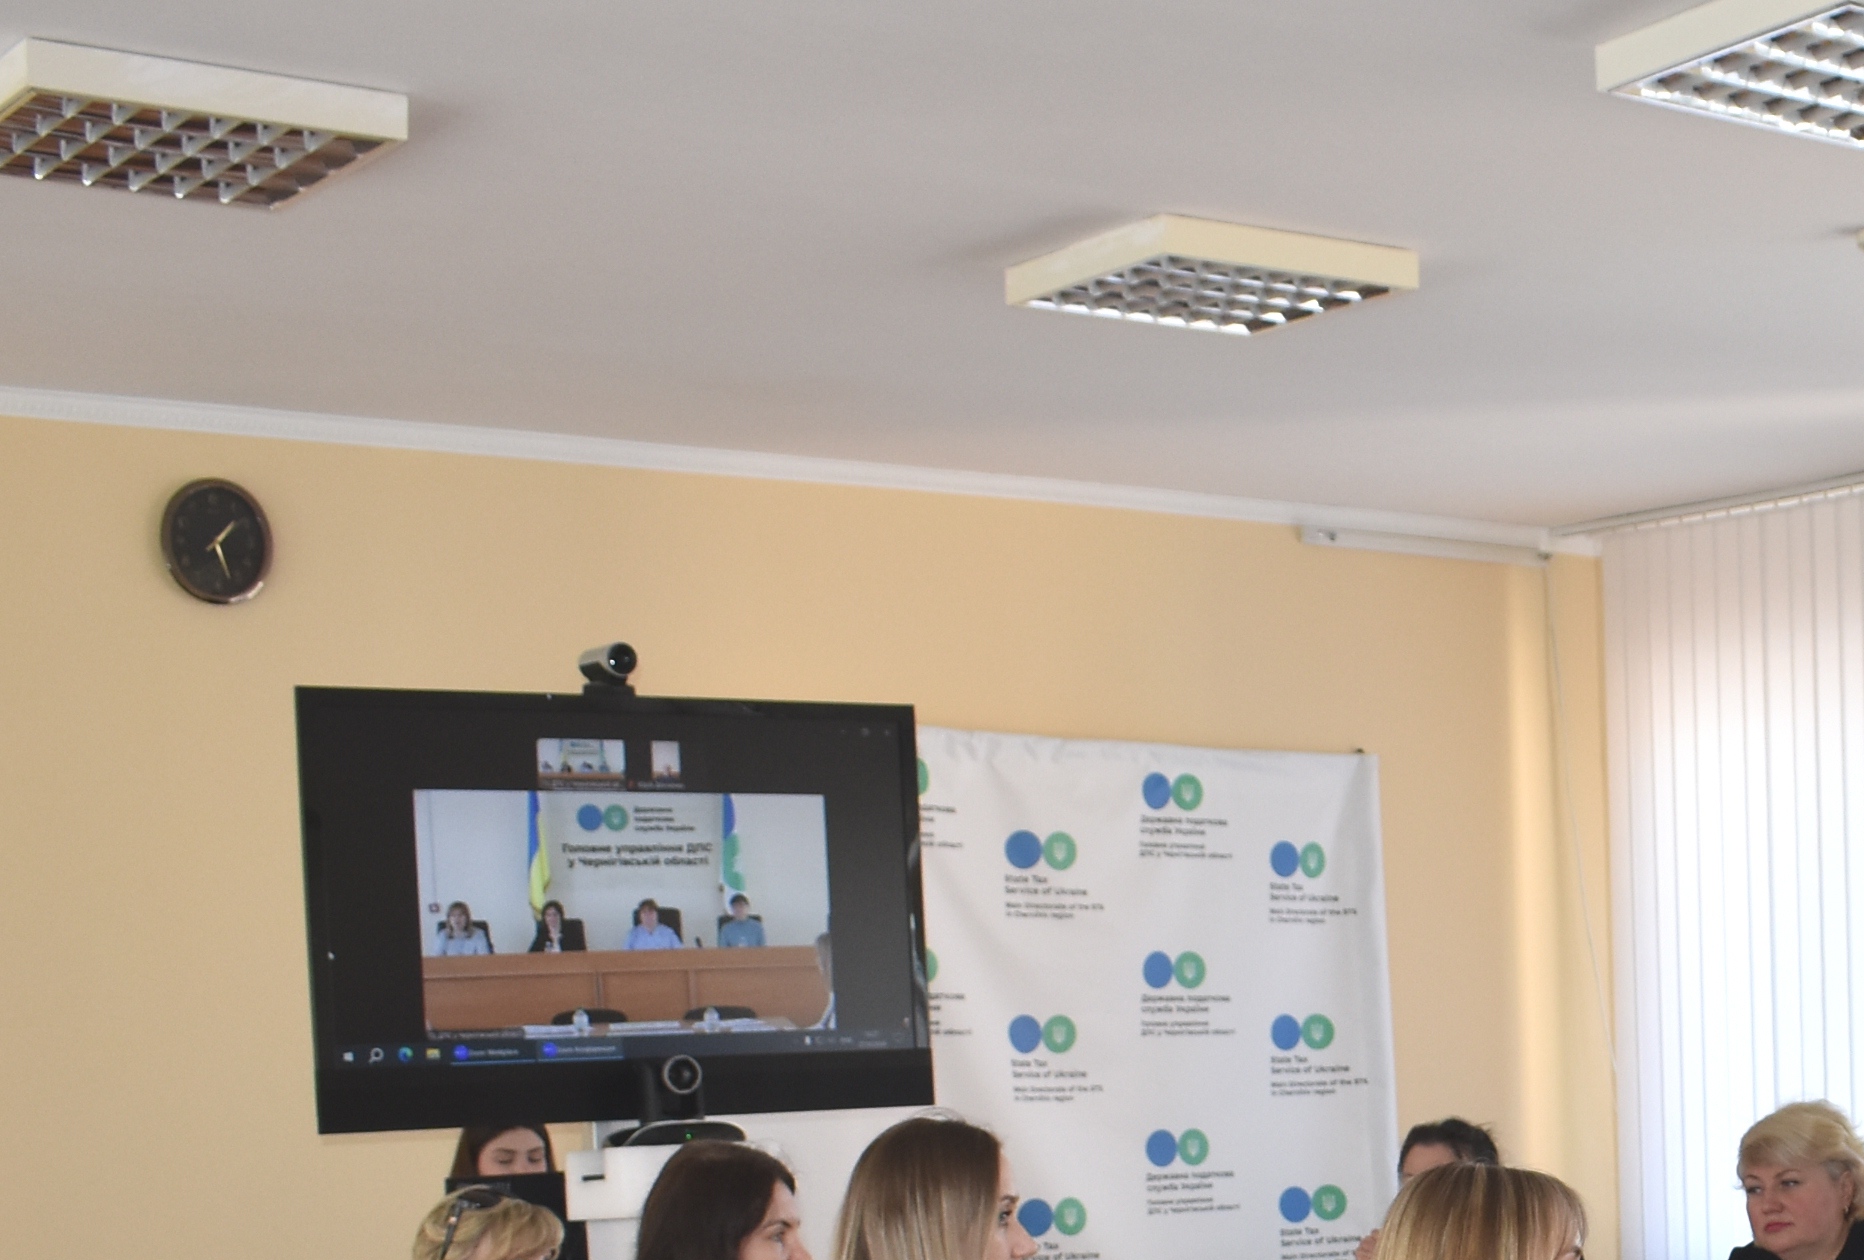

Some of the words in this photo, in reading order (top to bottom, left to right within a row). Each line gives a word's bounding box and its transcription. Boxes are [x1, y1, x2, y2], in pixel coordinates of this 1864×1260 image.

[562, 843, 611, 853] Головне
[616, 843, 684, 855] управління
[686, 842, 713, 853] ДПС
[567, 858, 575, 869] у
[578, 856, 661, 868] Чернігівській
[664, 856, 709, 866] області
